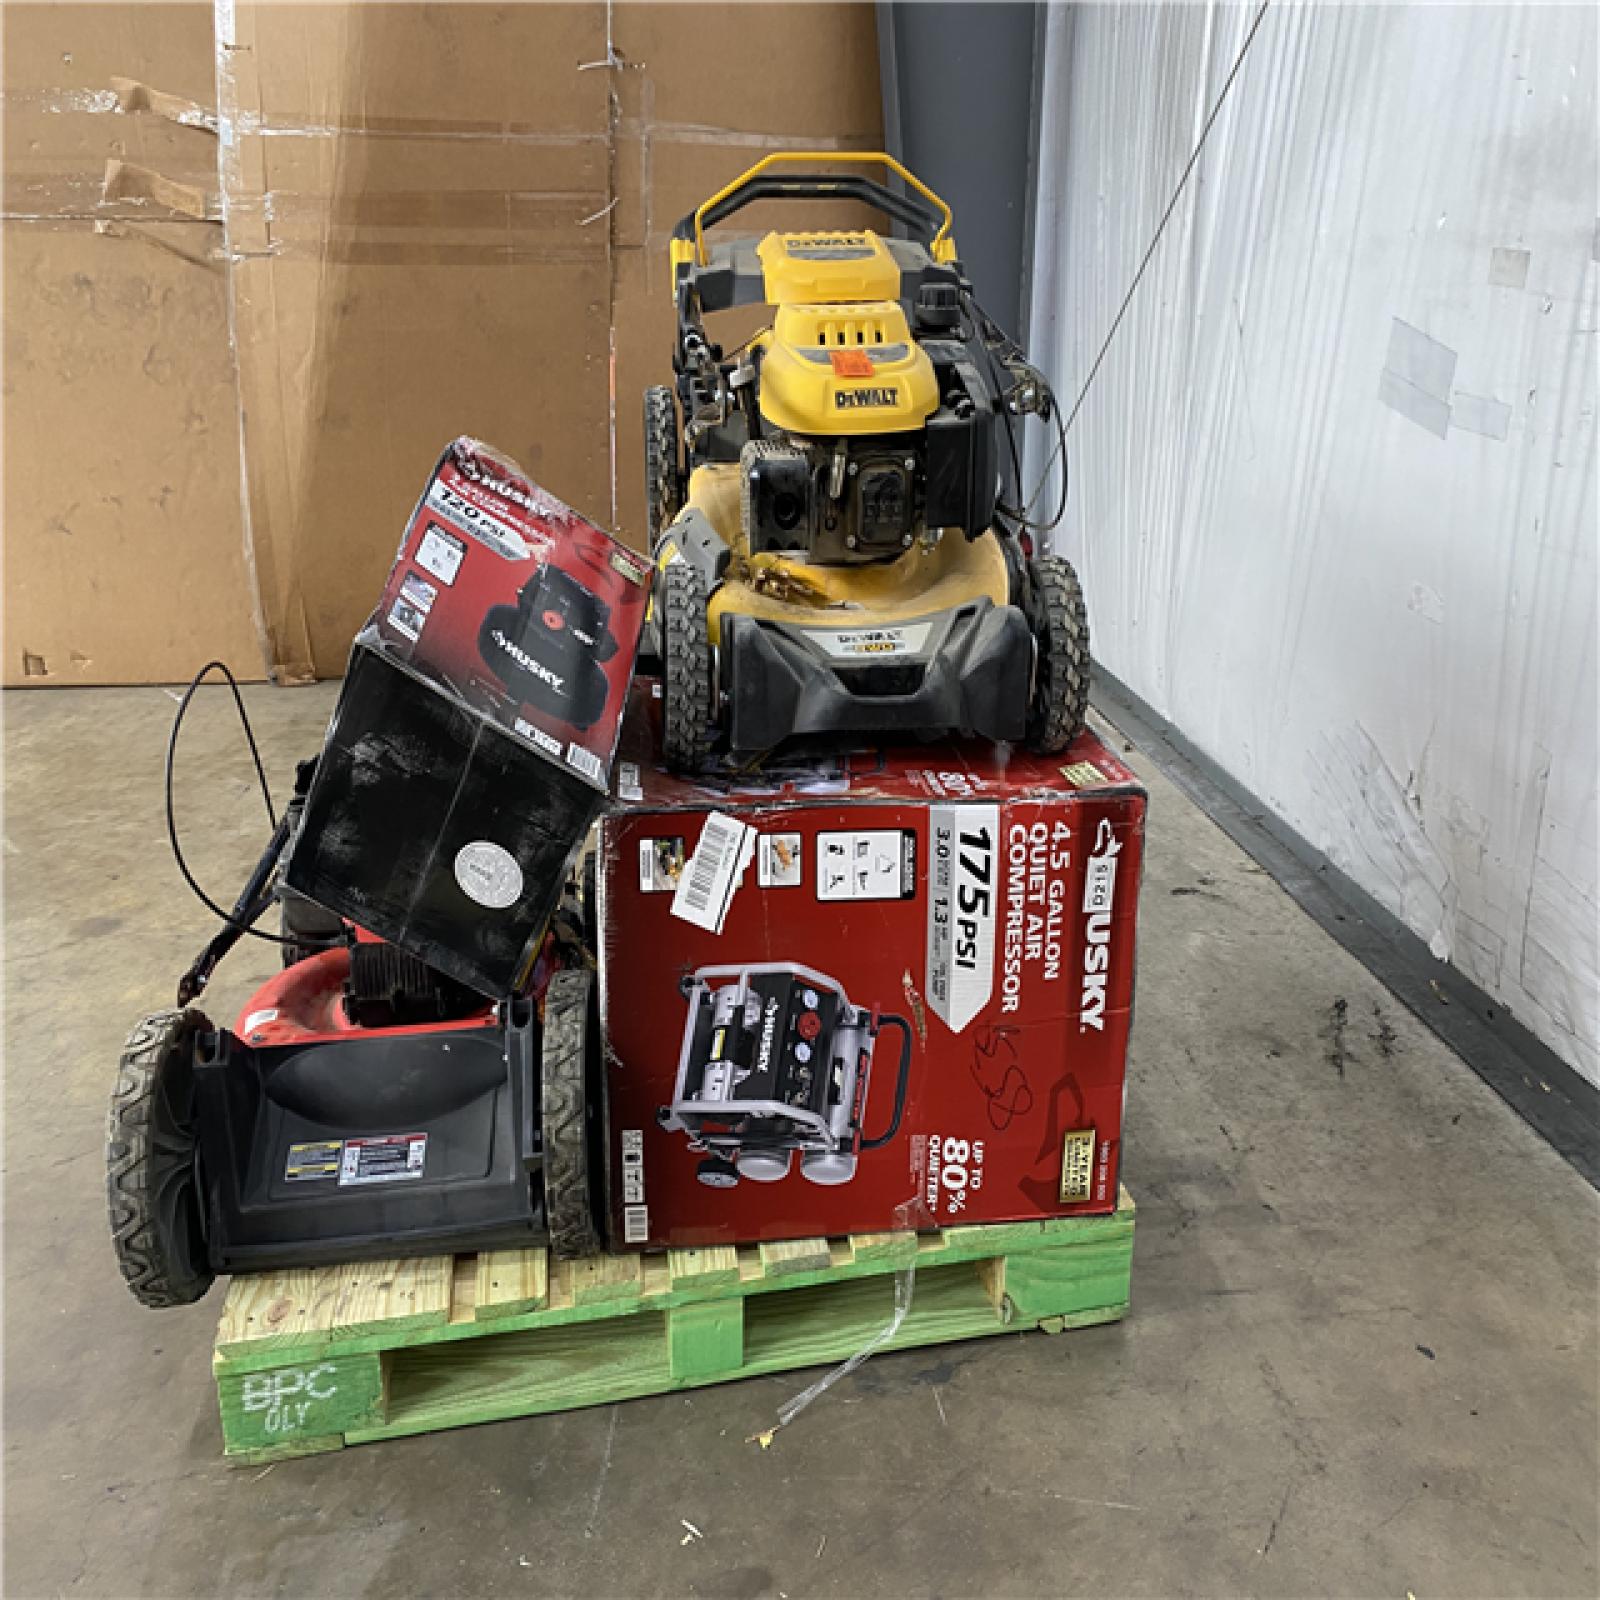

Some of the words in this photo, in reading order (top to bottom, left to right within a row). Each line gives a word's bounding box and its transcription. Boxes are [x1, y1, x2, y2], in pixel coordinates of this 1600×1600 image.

[835, 387, 897, 409] DEWALT
[441, 489, 480, 519] 120
[503, 637, 566, 690] HUSKY
[936, 826, 950, 859] 3.0
[1028, 821, 1049, 906] QUIET
[1051, 820, 1071, 870] 4.5
[957, 826, 991, 917] 175
[934, 899, 948, 925] 1.3
[1001, 824, 1027, 1013] COMPRESSOR
[1024, 914, 1046, 960] AIR
[1044, 879, 1065, 980] GALLON
[955, 918, 978, 971] PSI
[1080, 911, 1111, 1032] USKY
[757, 1016, 775, 1073] HUSKY
[942, 1137, 970, 1214] 80%
[972, 1139, 984, 1164] UP
[970, 1169, 983, 1191] TO
[242, 1362, 337, 1411] BPC
